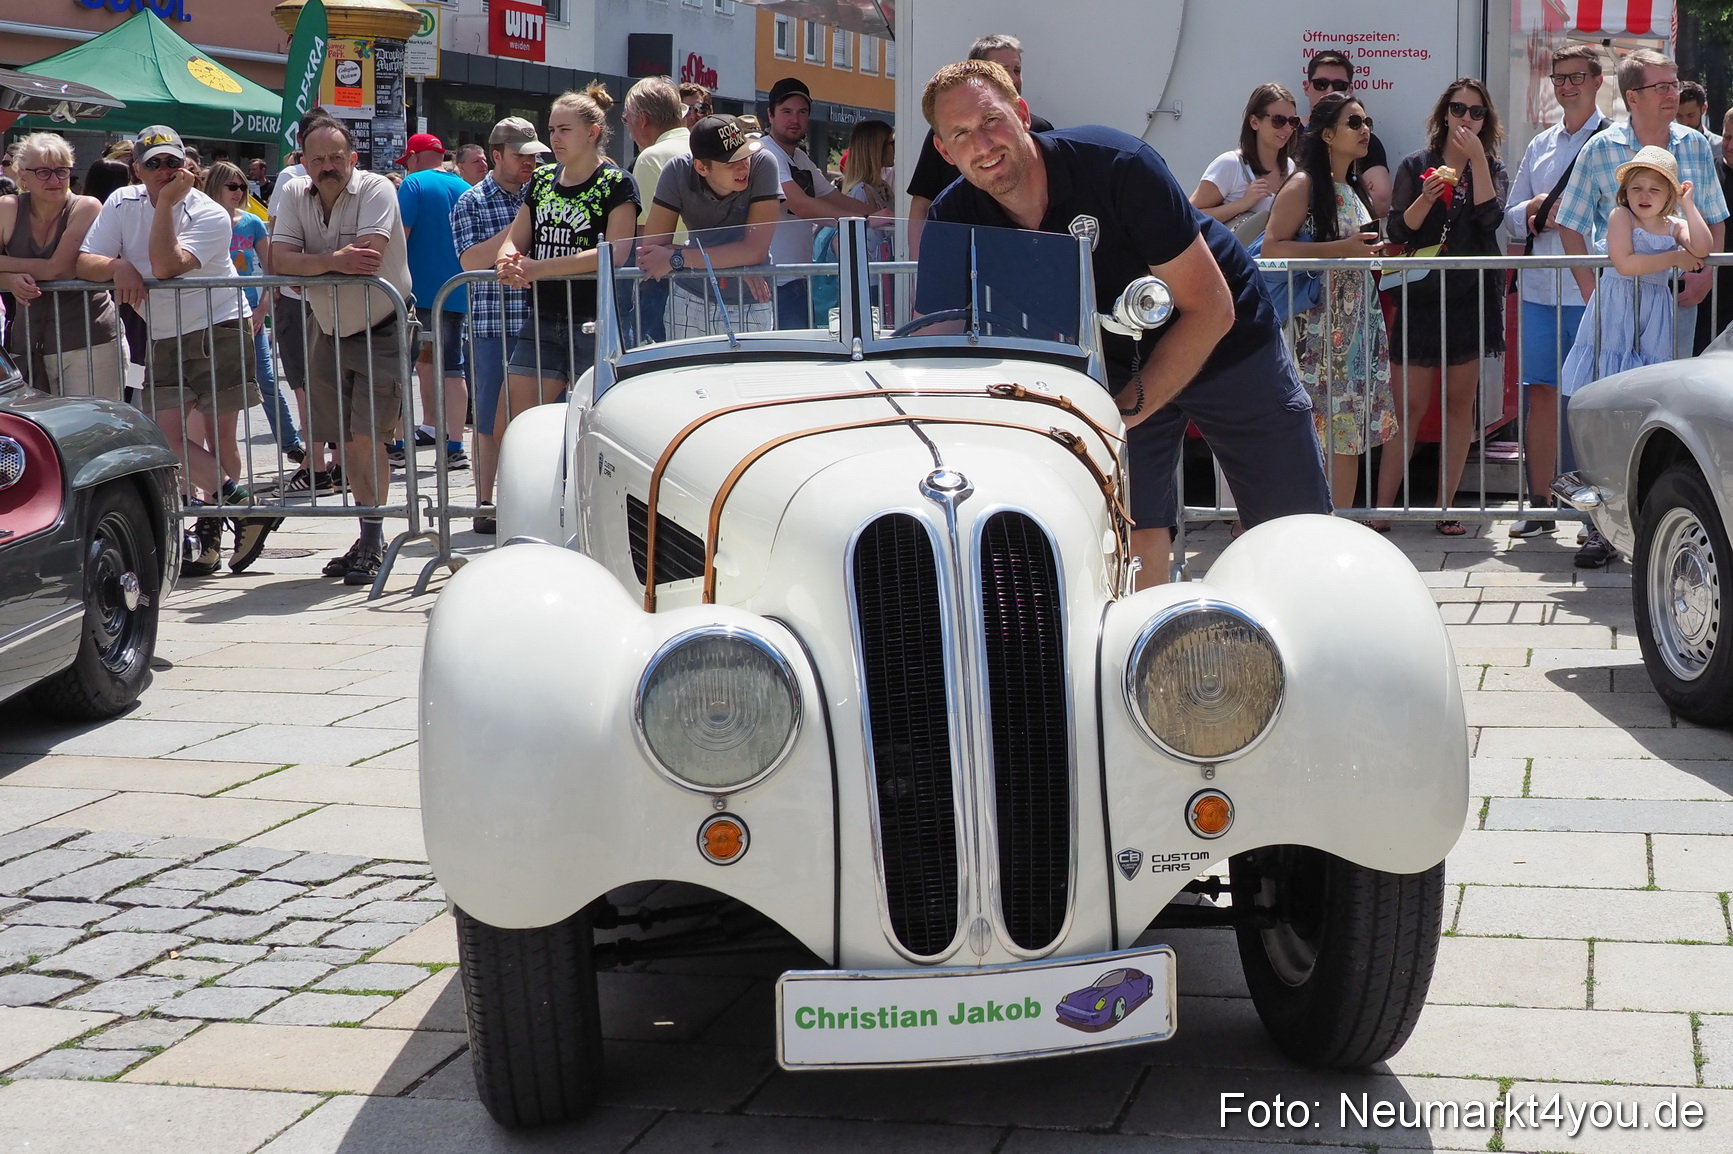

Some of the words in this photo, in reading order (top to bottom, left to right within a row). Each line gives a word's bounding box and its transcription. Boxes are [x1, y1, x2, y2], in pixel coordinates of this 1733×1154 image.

[505, 9, 544, 41] WITT
[1303, 30, 1400, 44] Öffnungszeiten:
[509, 41, 531, 52] weiden
[1357, 48, 1432, 60] Donnerstag,
[296, 36, 324, 114] DEKRA
[1372, 79, 1394, 90] Uhr
[540, 226, 572, 245] STATE
[1119, 853, 1141, 863] CB
[1151, 851, 1210, 863] CUSTOM
[1151, 863, 1191, 873] CARS
[795, 1003, 939, 1030] Christian
[948, 997, 1042, 1025] Jakob
